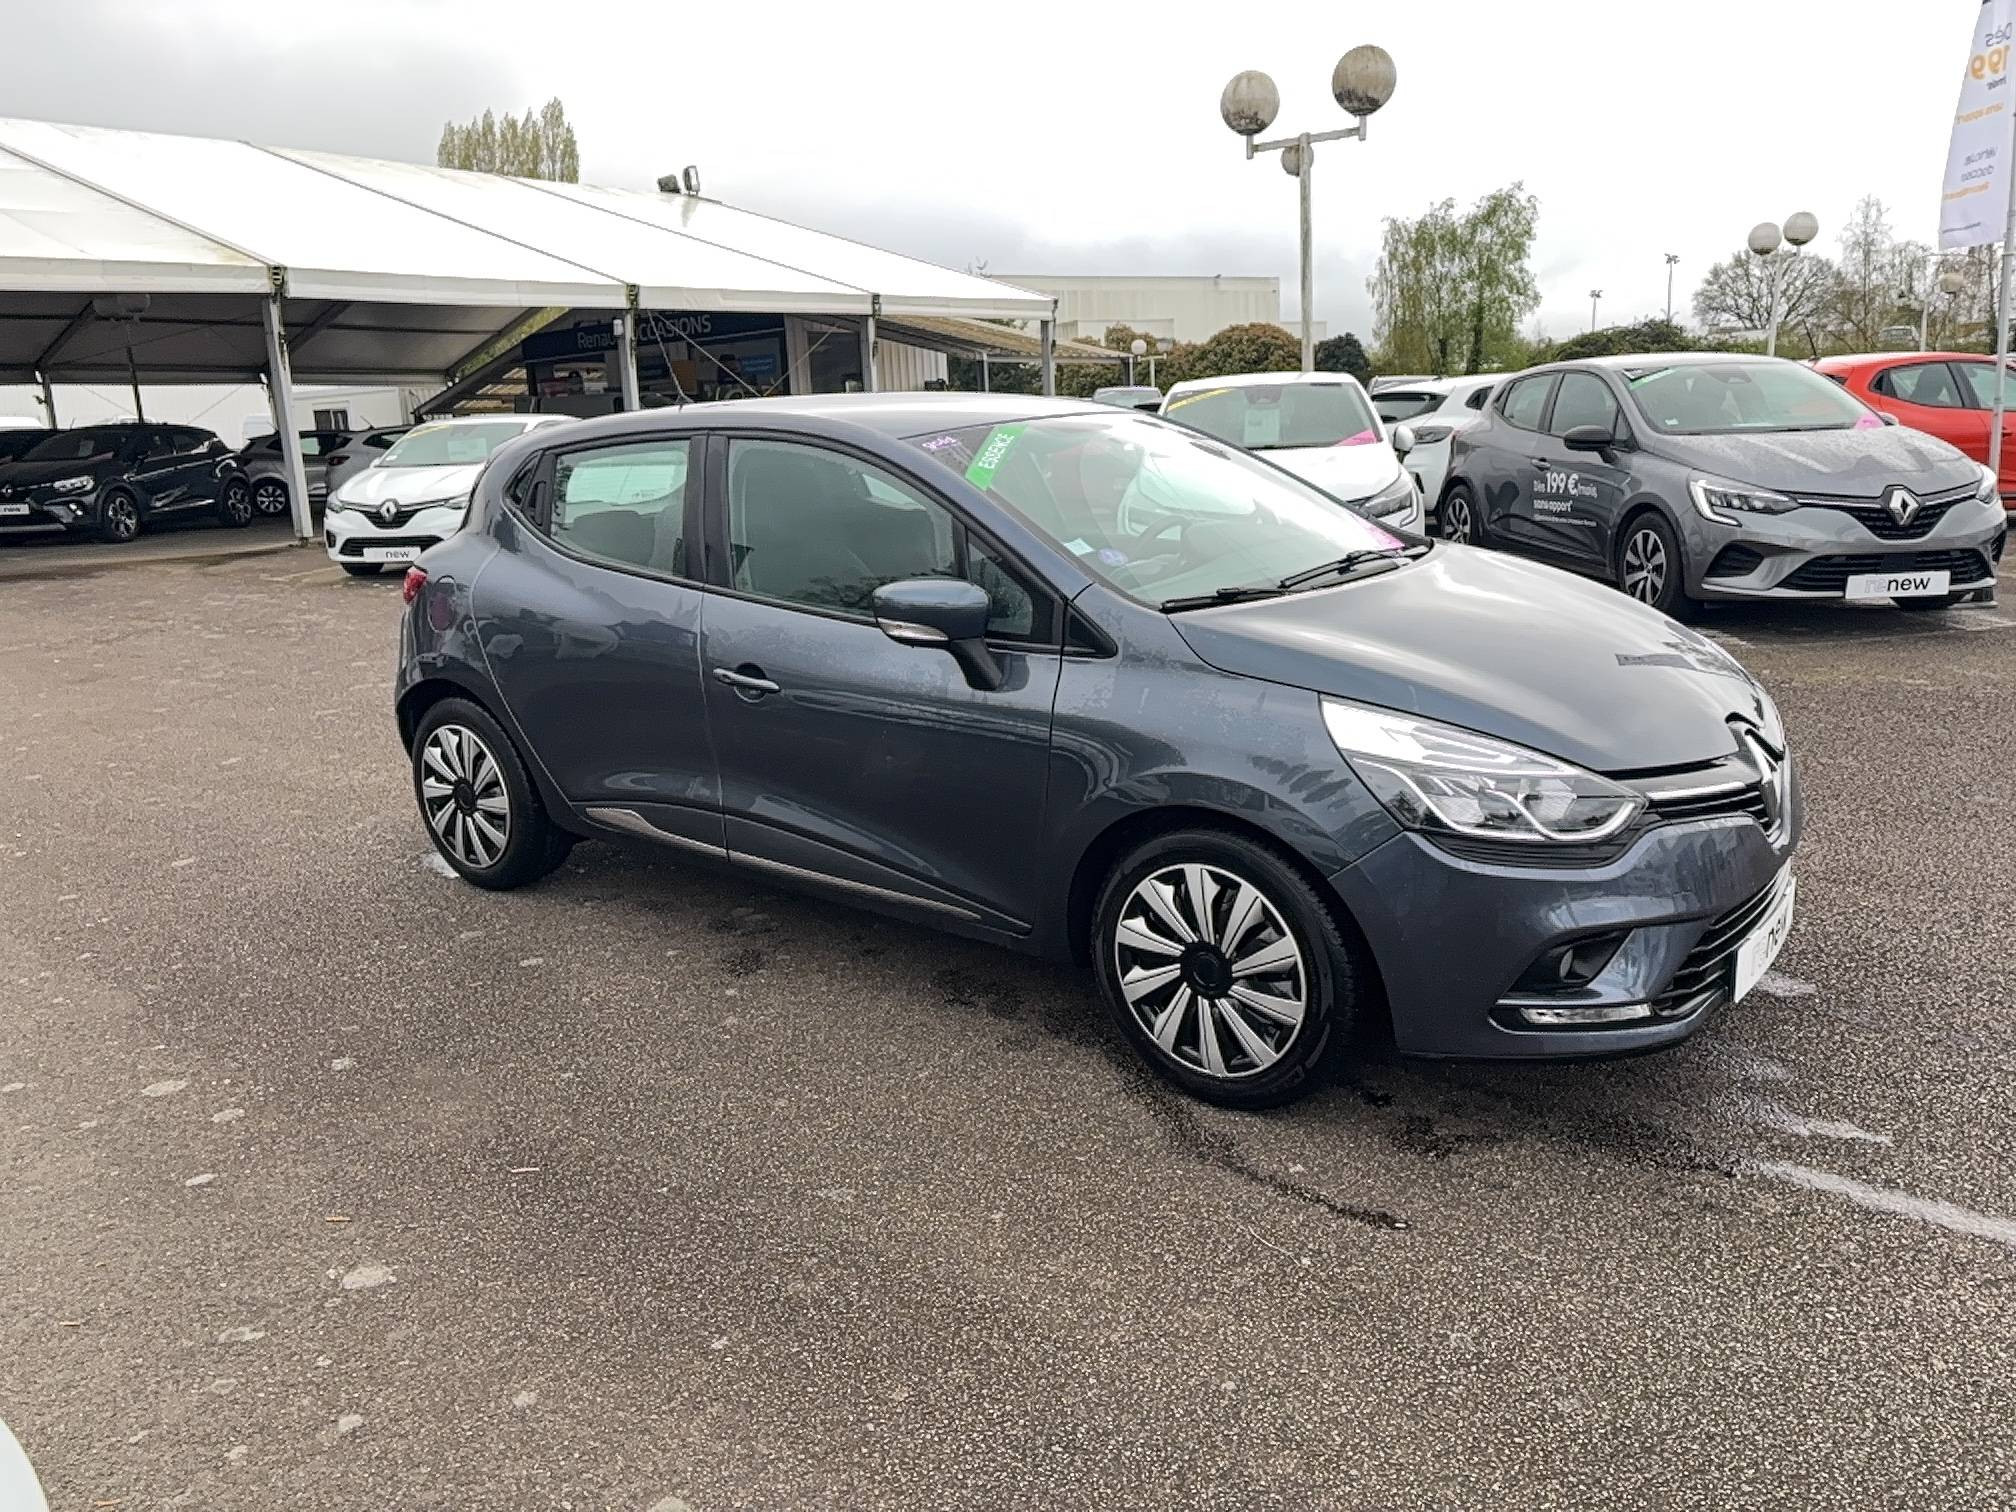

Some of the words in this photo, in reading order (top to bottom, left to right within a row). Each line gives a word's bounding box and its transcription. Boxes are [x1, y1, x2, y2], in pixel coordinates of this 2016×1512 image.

[639, 314, 711, 341] CCASIONS
[978, 433, 1015, 469] ESSENCE
[1546, 472, 1567, 494] 199
